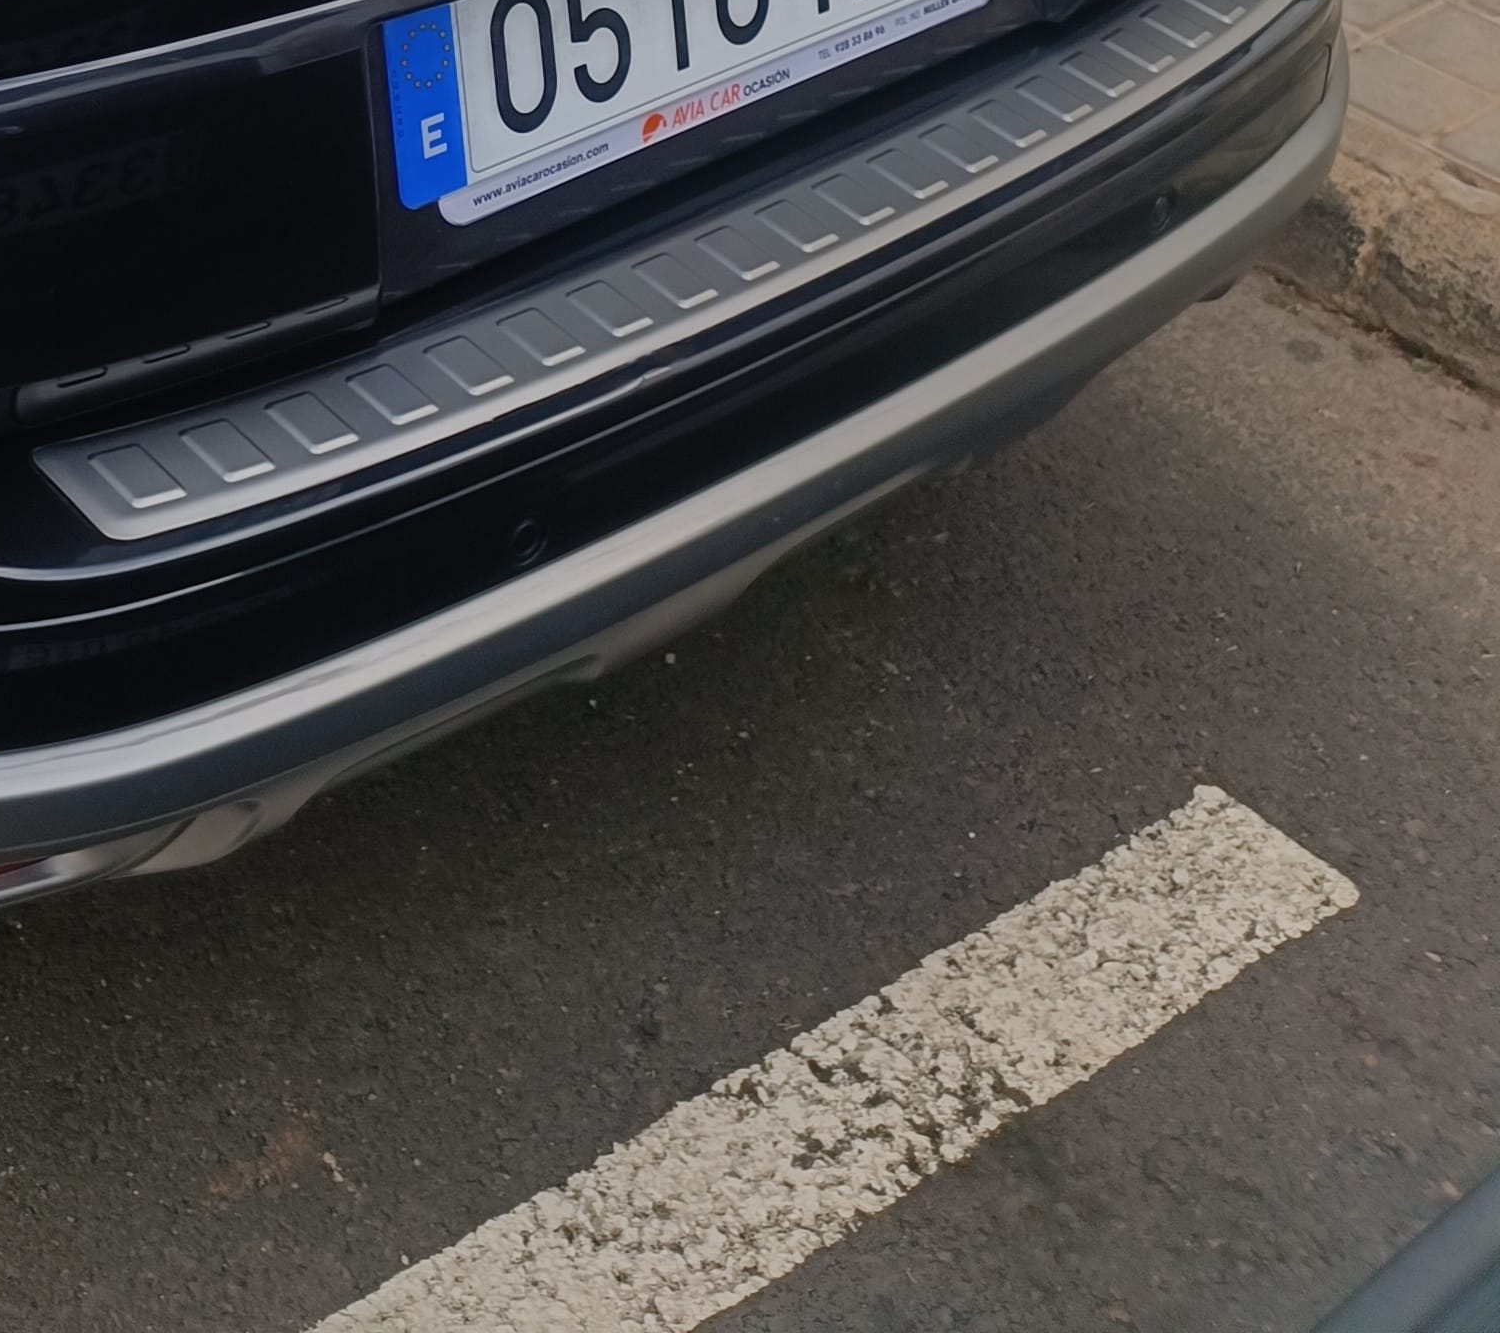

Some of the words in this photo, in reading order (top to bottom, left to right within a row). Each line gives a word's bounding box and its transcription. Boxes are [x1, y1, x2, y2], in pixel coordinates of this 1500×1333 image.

[671, 98, 705, 129] AVIA
[710, 83, 741, 111] CAR
[743, 68, 790, 97] OCASIÓN
[420, 111, 448, 160] E
[472, 141, 609, 208] www.aviacarocasion.com
